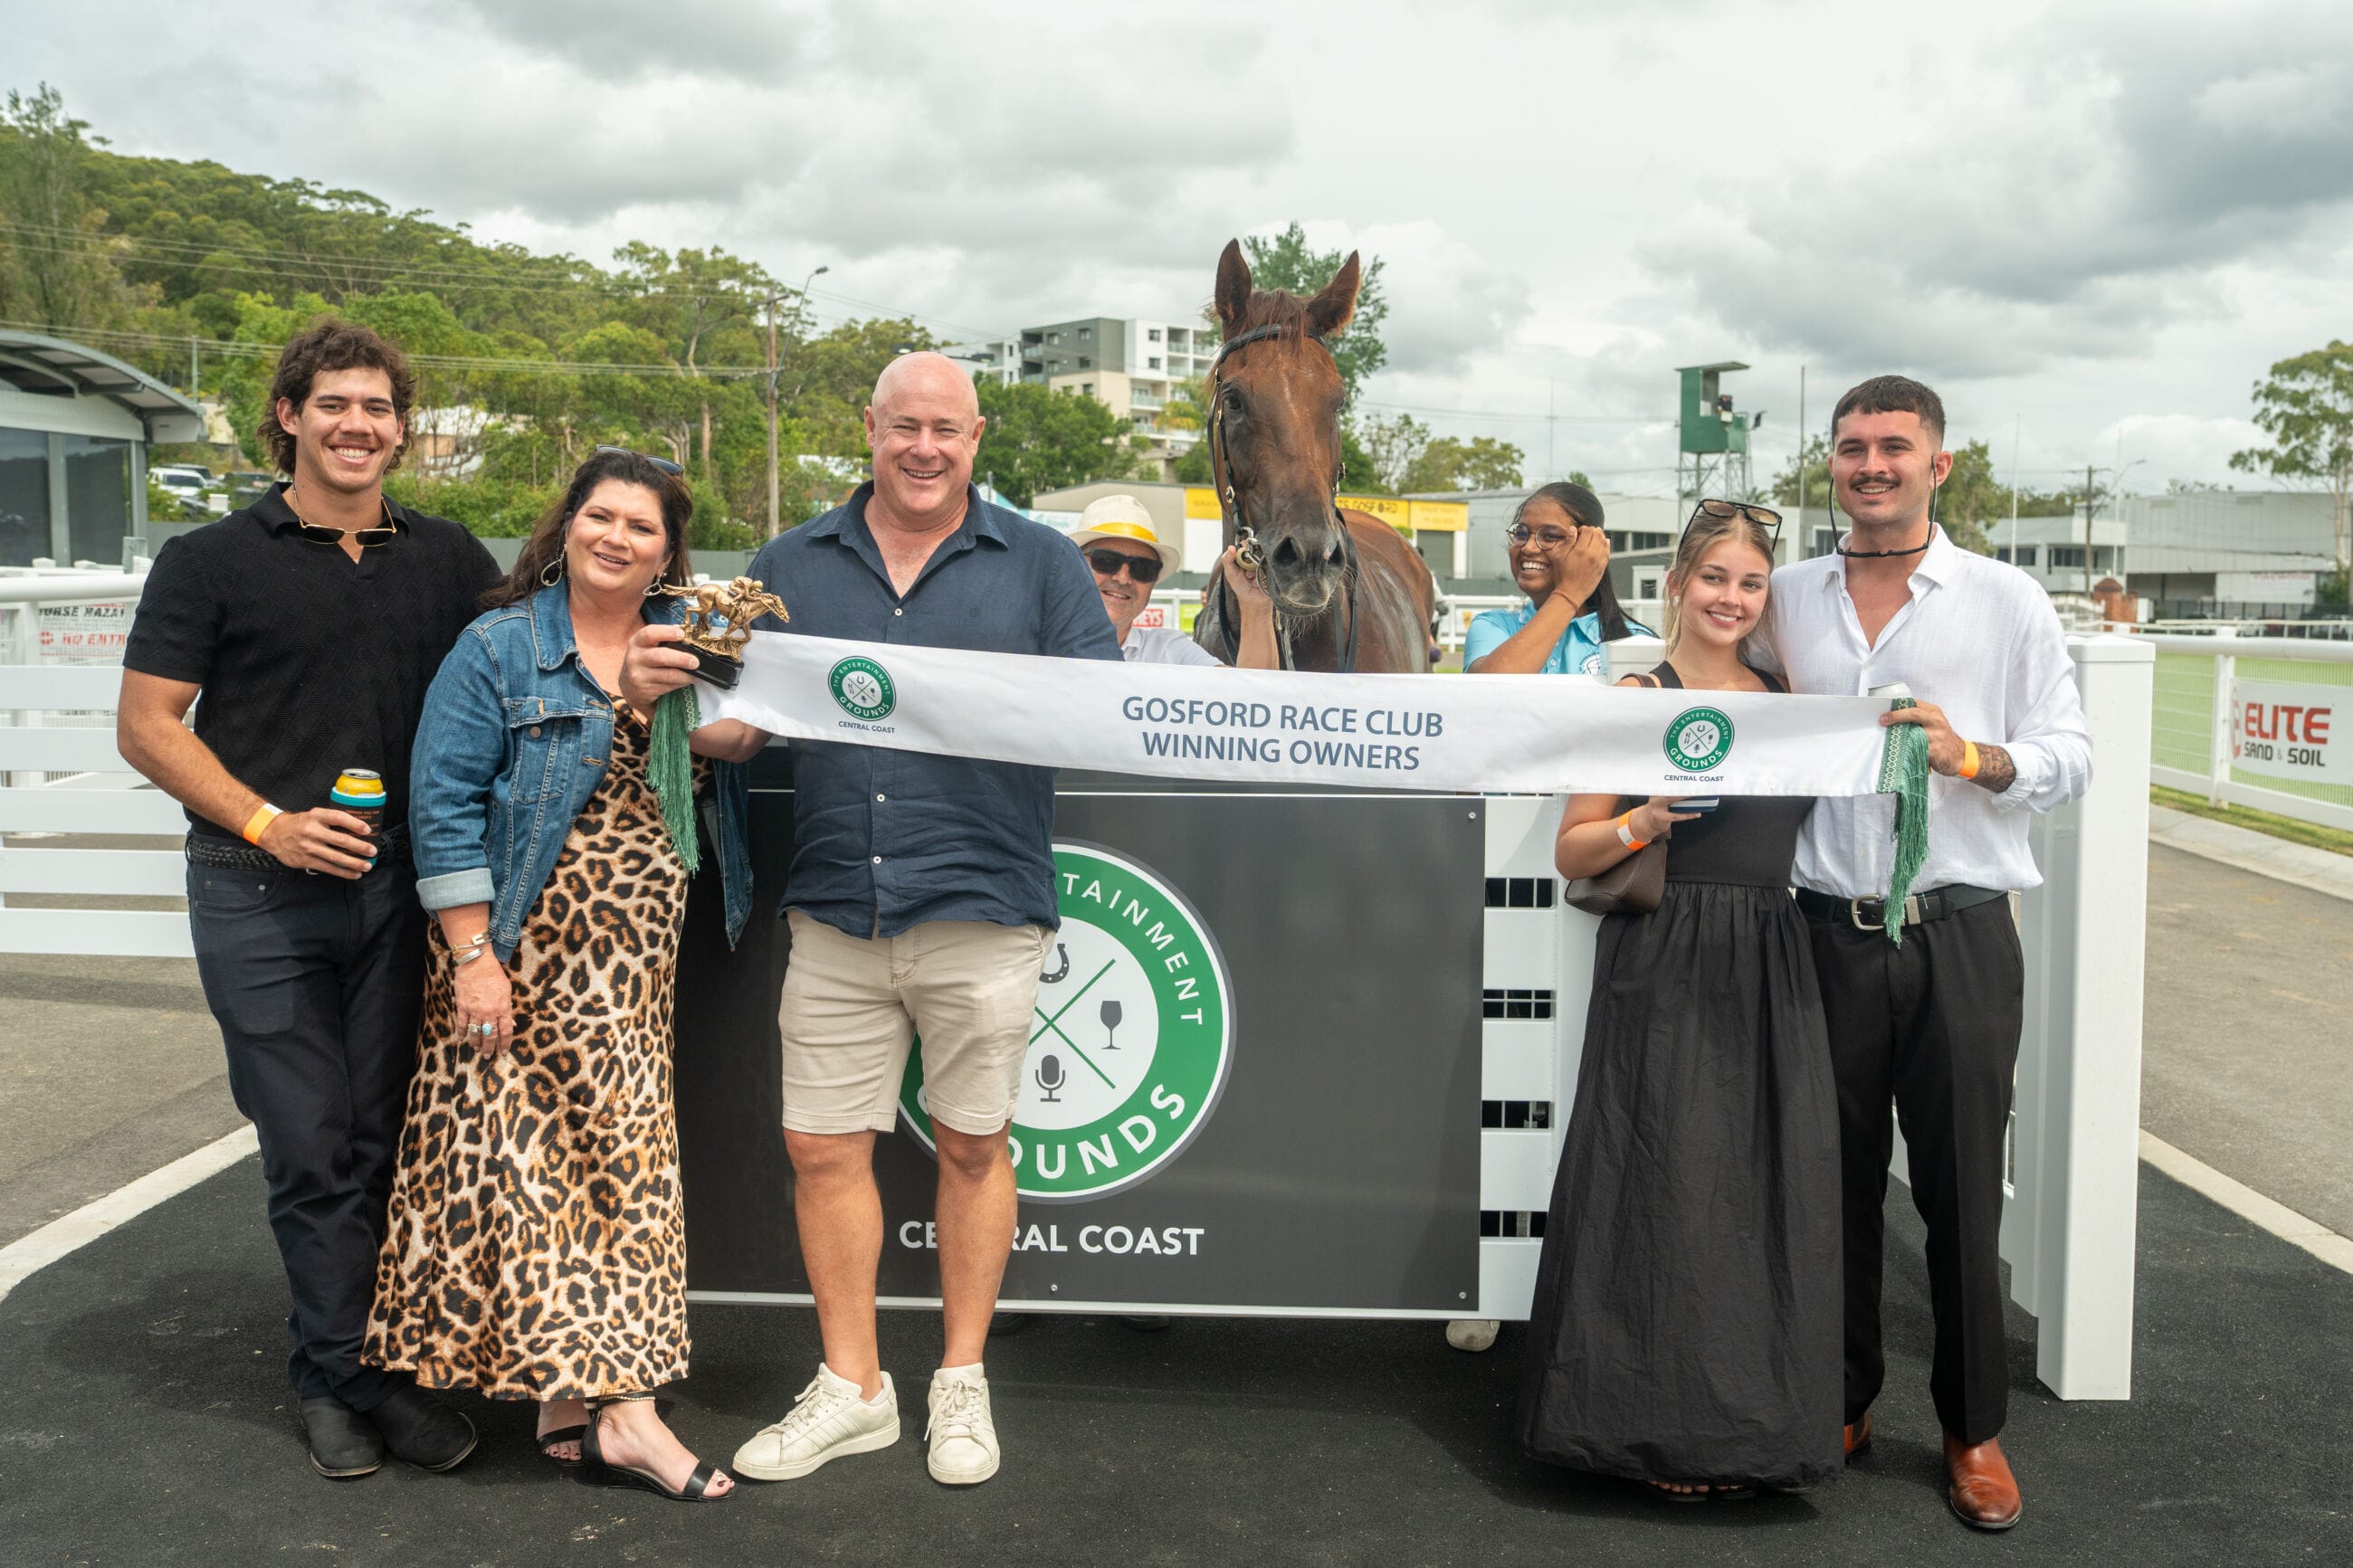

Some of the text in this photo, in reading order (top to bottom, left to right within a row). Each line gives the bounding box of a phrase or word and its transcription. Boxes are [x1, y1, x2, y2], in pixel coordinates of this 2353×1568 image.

[87, 633, 126, 645] ENTR
[839, 661, 891, 695] ENTERTAINMENT
[840, 697, 890, 717] GROUNDS
[1122, 696, 1443, 737] GOSFORD RACE CLUB
[838, 720, 895, 734] CENTRAL COAST
[1670, 712, 1728, 739] THE ENTERTAINMENT
[2245, 701, 2331, 745] ELITE
[1142, 731, 1420, 770] WINNING OWNERS
[1670, 747, 1722, 768] GROUNDS
[2244, 741, 2273, 761] SAND
[2287, 747, 2326, 767] SOIL
[1062, 872, 1203, 1025] TAINMENT
[899, 1221, 1205, 1255] CEAL COAST
